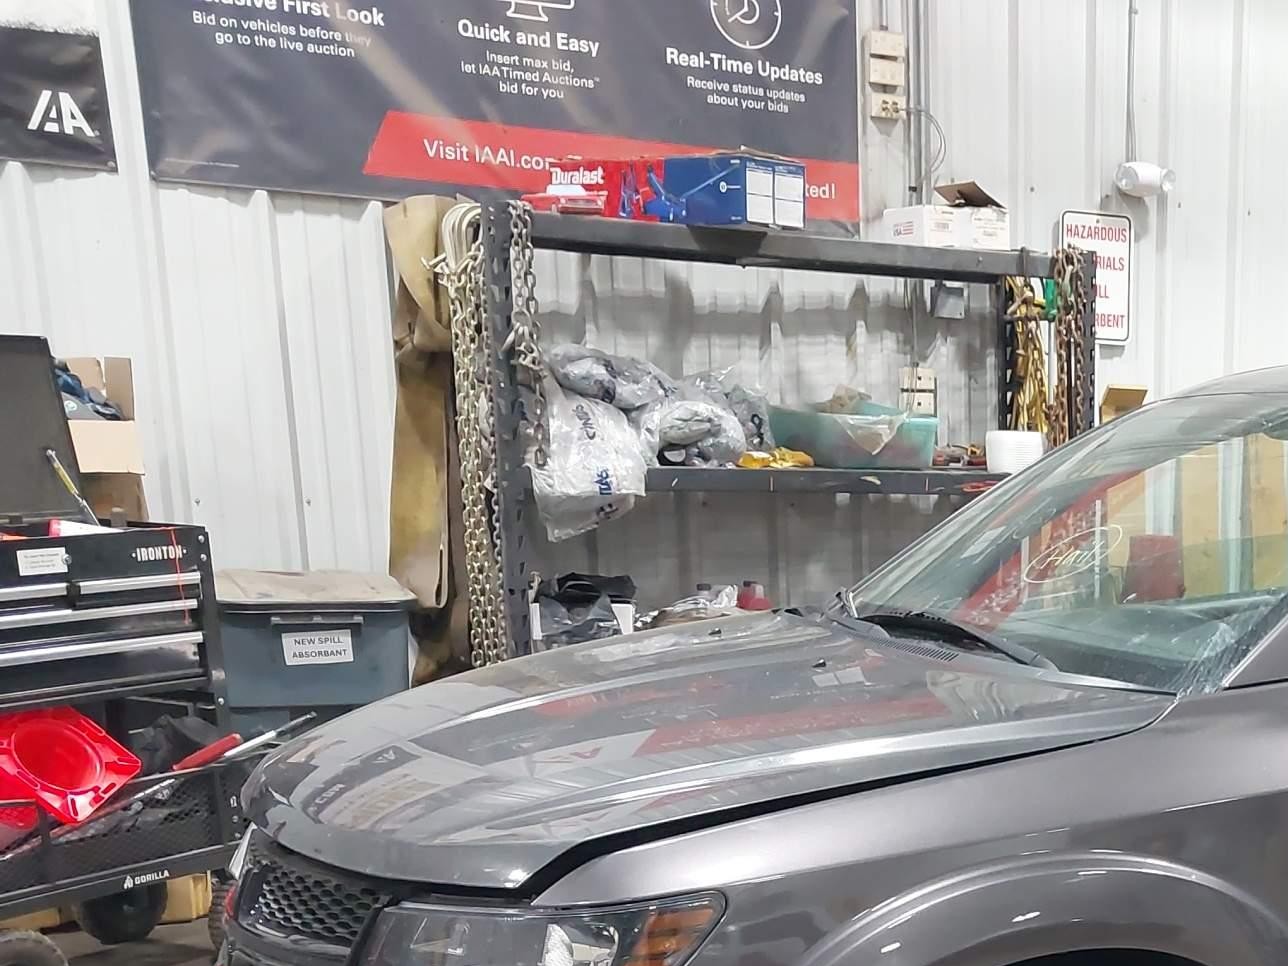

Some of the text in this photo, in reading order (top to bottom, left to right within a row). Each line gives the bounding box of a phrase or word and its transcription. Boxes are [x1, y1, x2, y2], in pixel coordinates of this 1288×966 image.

[335, 3, 385, 26] Look
[192, 10, 216, 26] Bid
[219, 17, 237, 28] on
[241, 18, 296, 35] vehicles
[299, 25, 342, 41] before
[215, 32, 355, 58] go to the live auction
[457, 19, 600, 57] Quick and Easy
[461, 61, 476, 74] let
[479, 64, 500, 77] IAA
[501, 66, 540, 82] Timed
[486, 50, 574, 73] Insert max bid,
[665, 47, 823, 85] Real-Time Updates
[499, 81, 564, 99] bid for you
[687, 76, 806, 102] Receive status updates
[707, 93, 789, 113] about your bids
[423, 139, 469, 162] Visit
[805, 183, 836, 200] ted!
[550, 165, 604, 185] Duralast
[1066, 224, 1127, 243] HAZARDOUS
[1095, 255, 1125, 271] RIALS
[1095, 313, 1125, 329] RBENT
[136, 545, 183, 562] IRONTON
[294, 636, 344, 646] NEW SPILL
[292, 648, 347, 659] ABSORBANT
[134, 869, 170, 885] GORILLA
